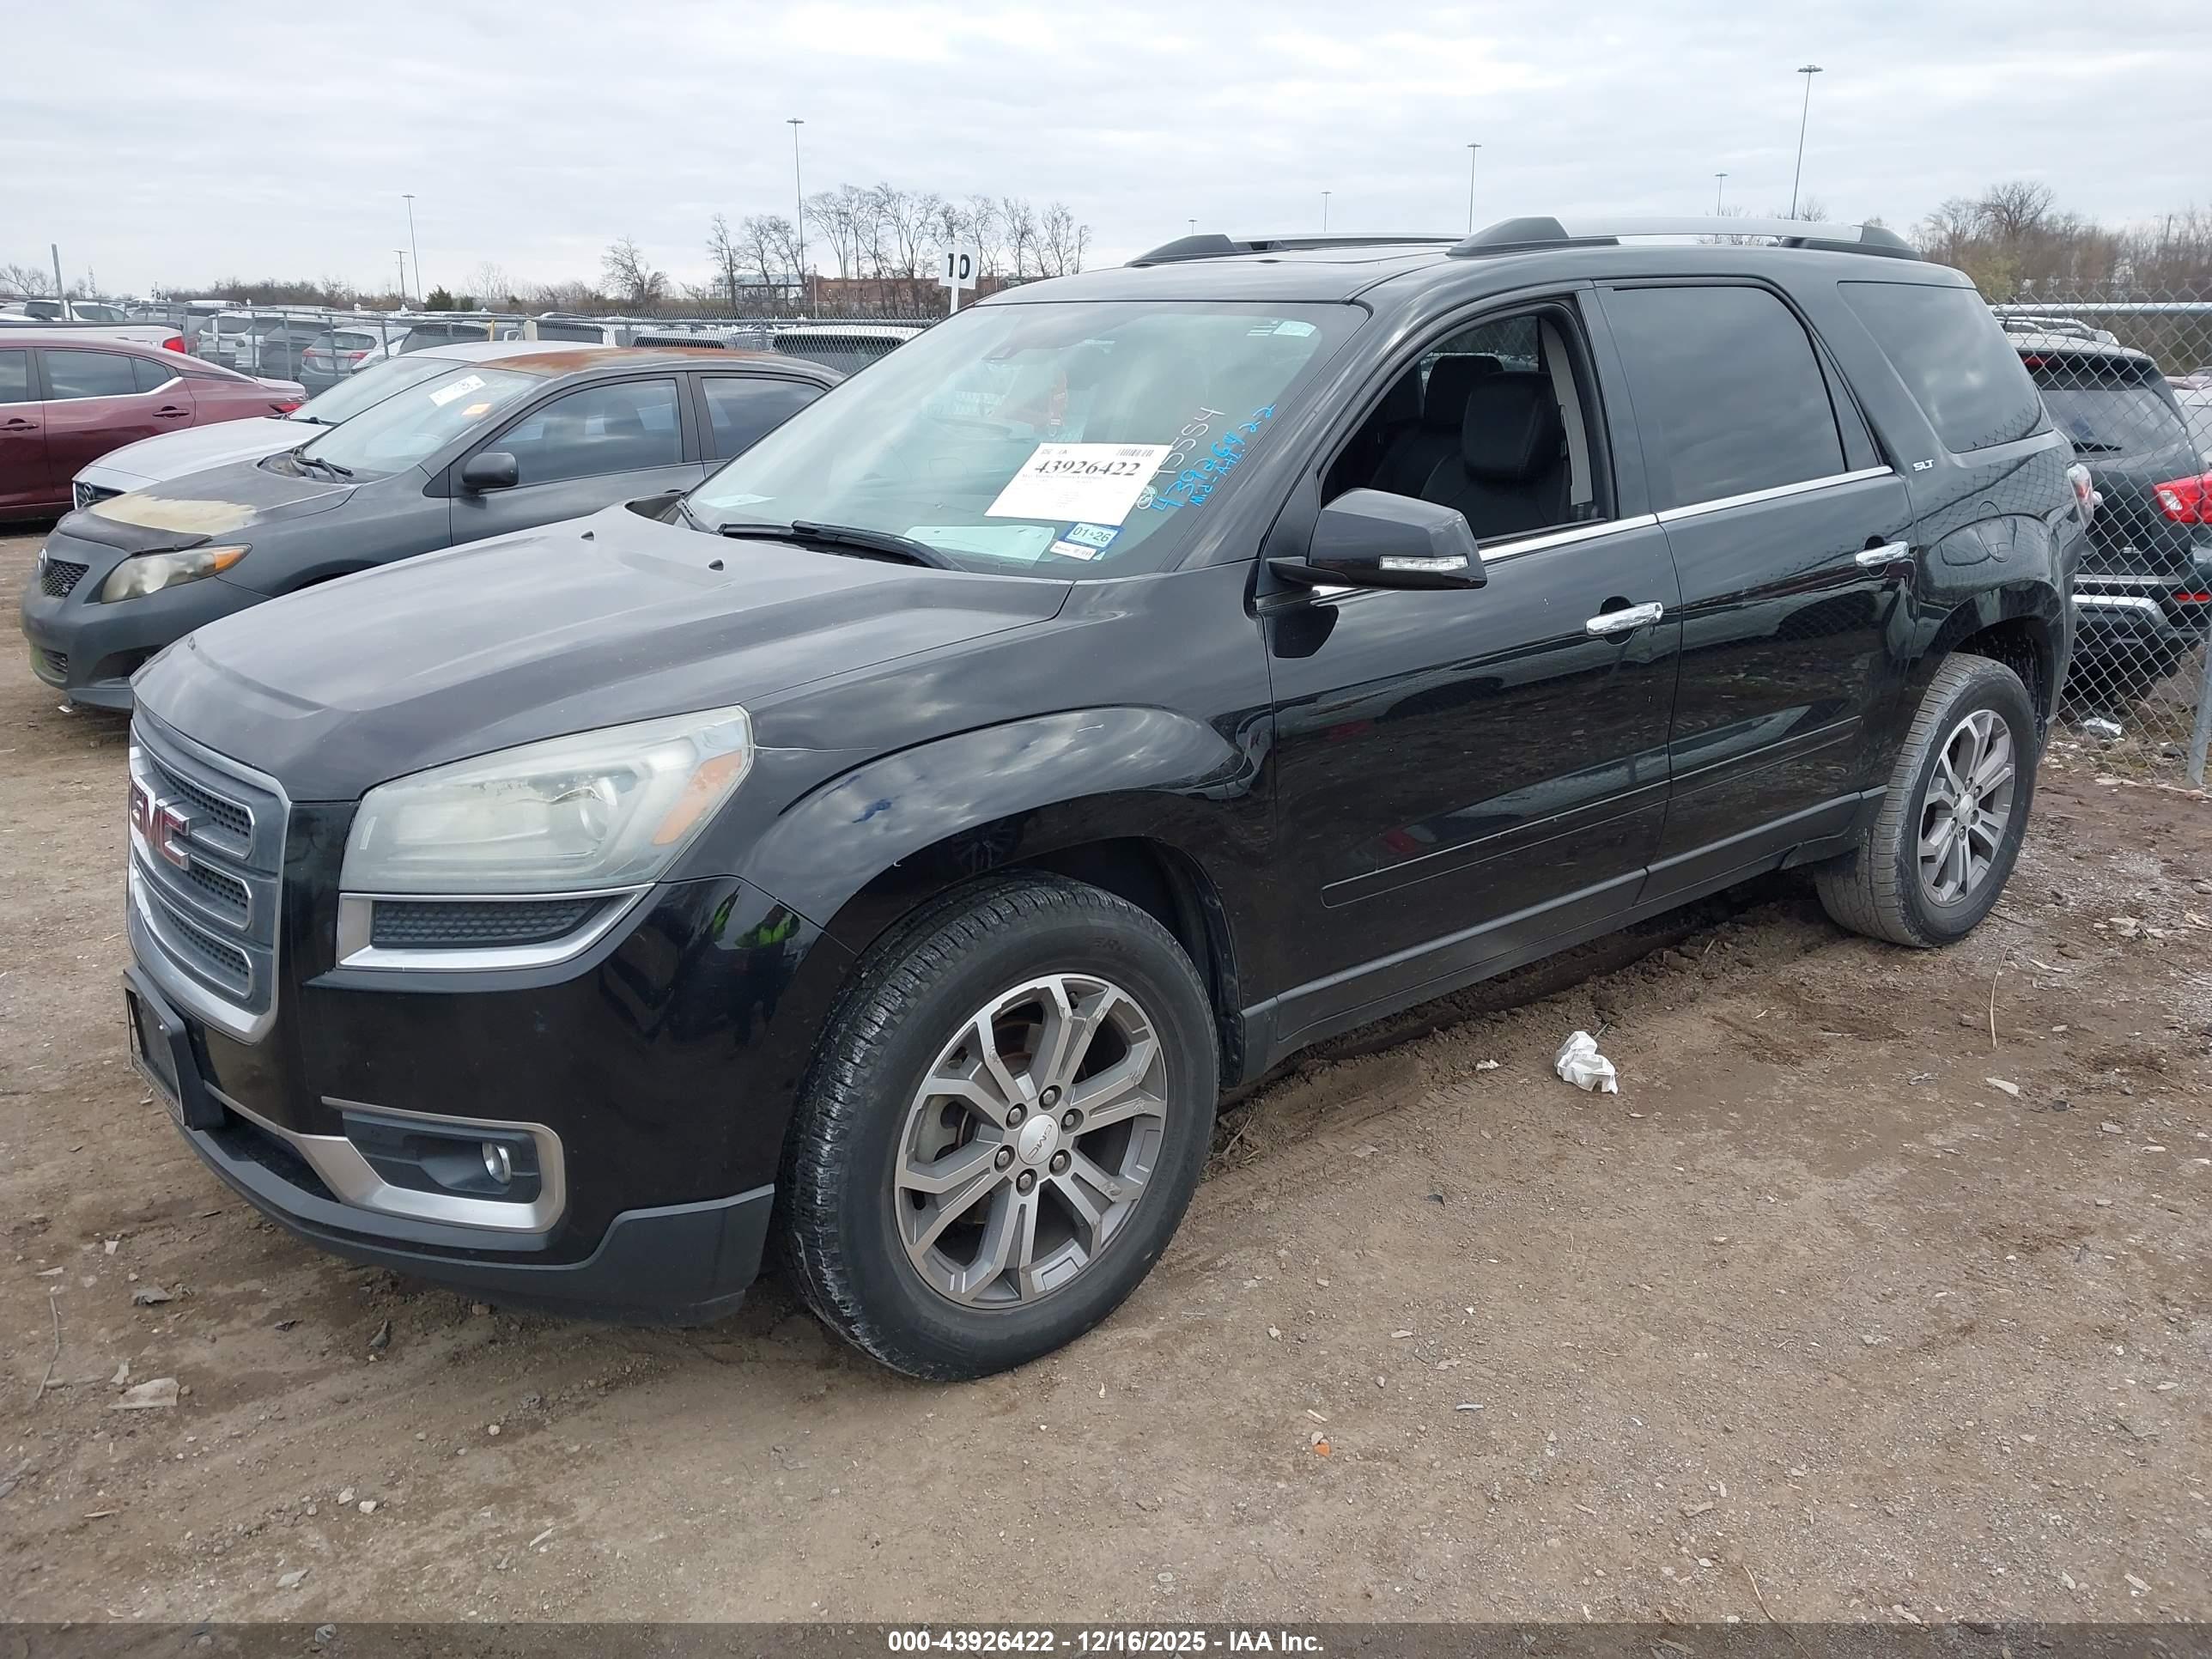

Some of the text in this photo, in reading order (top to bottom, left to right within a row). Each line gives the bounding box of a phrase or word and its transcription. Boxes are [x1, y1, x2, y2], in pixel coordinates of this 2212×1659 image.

[947, 252, 970, 279] 10
[1034, 459, 1141, 476] 43926422
[1912, 459, 1935, 472] SLT
[130, 775, 190, 872] GMC
[1027, 1123, 1054, 1160] GMC
